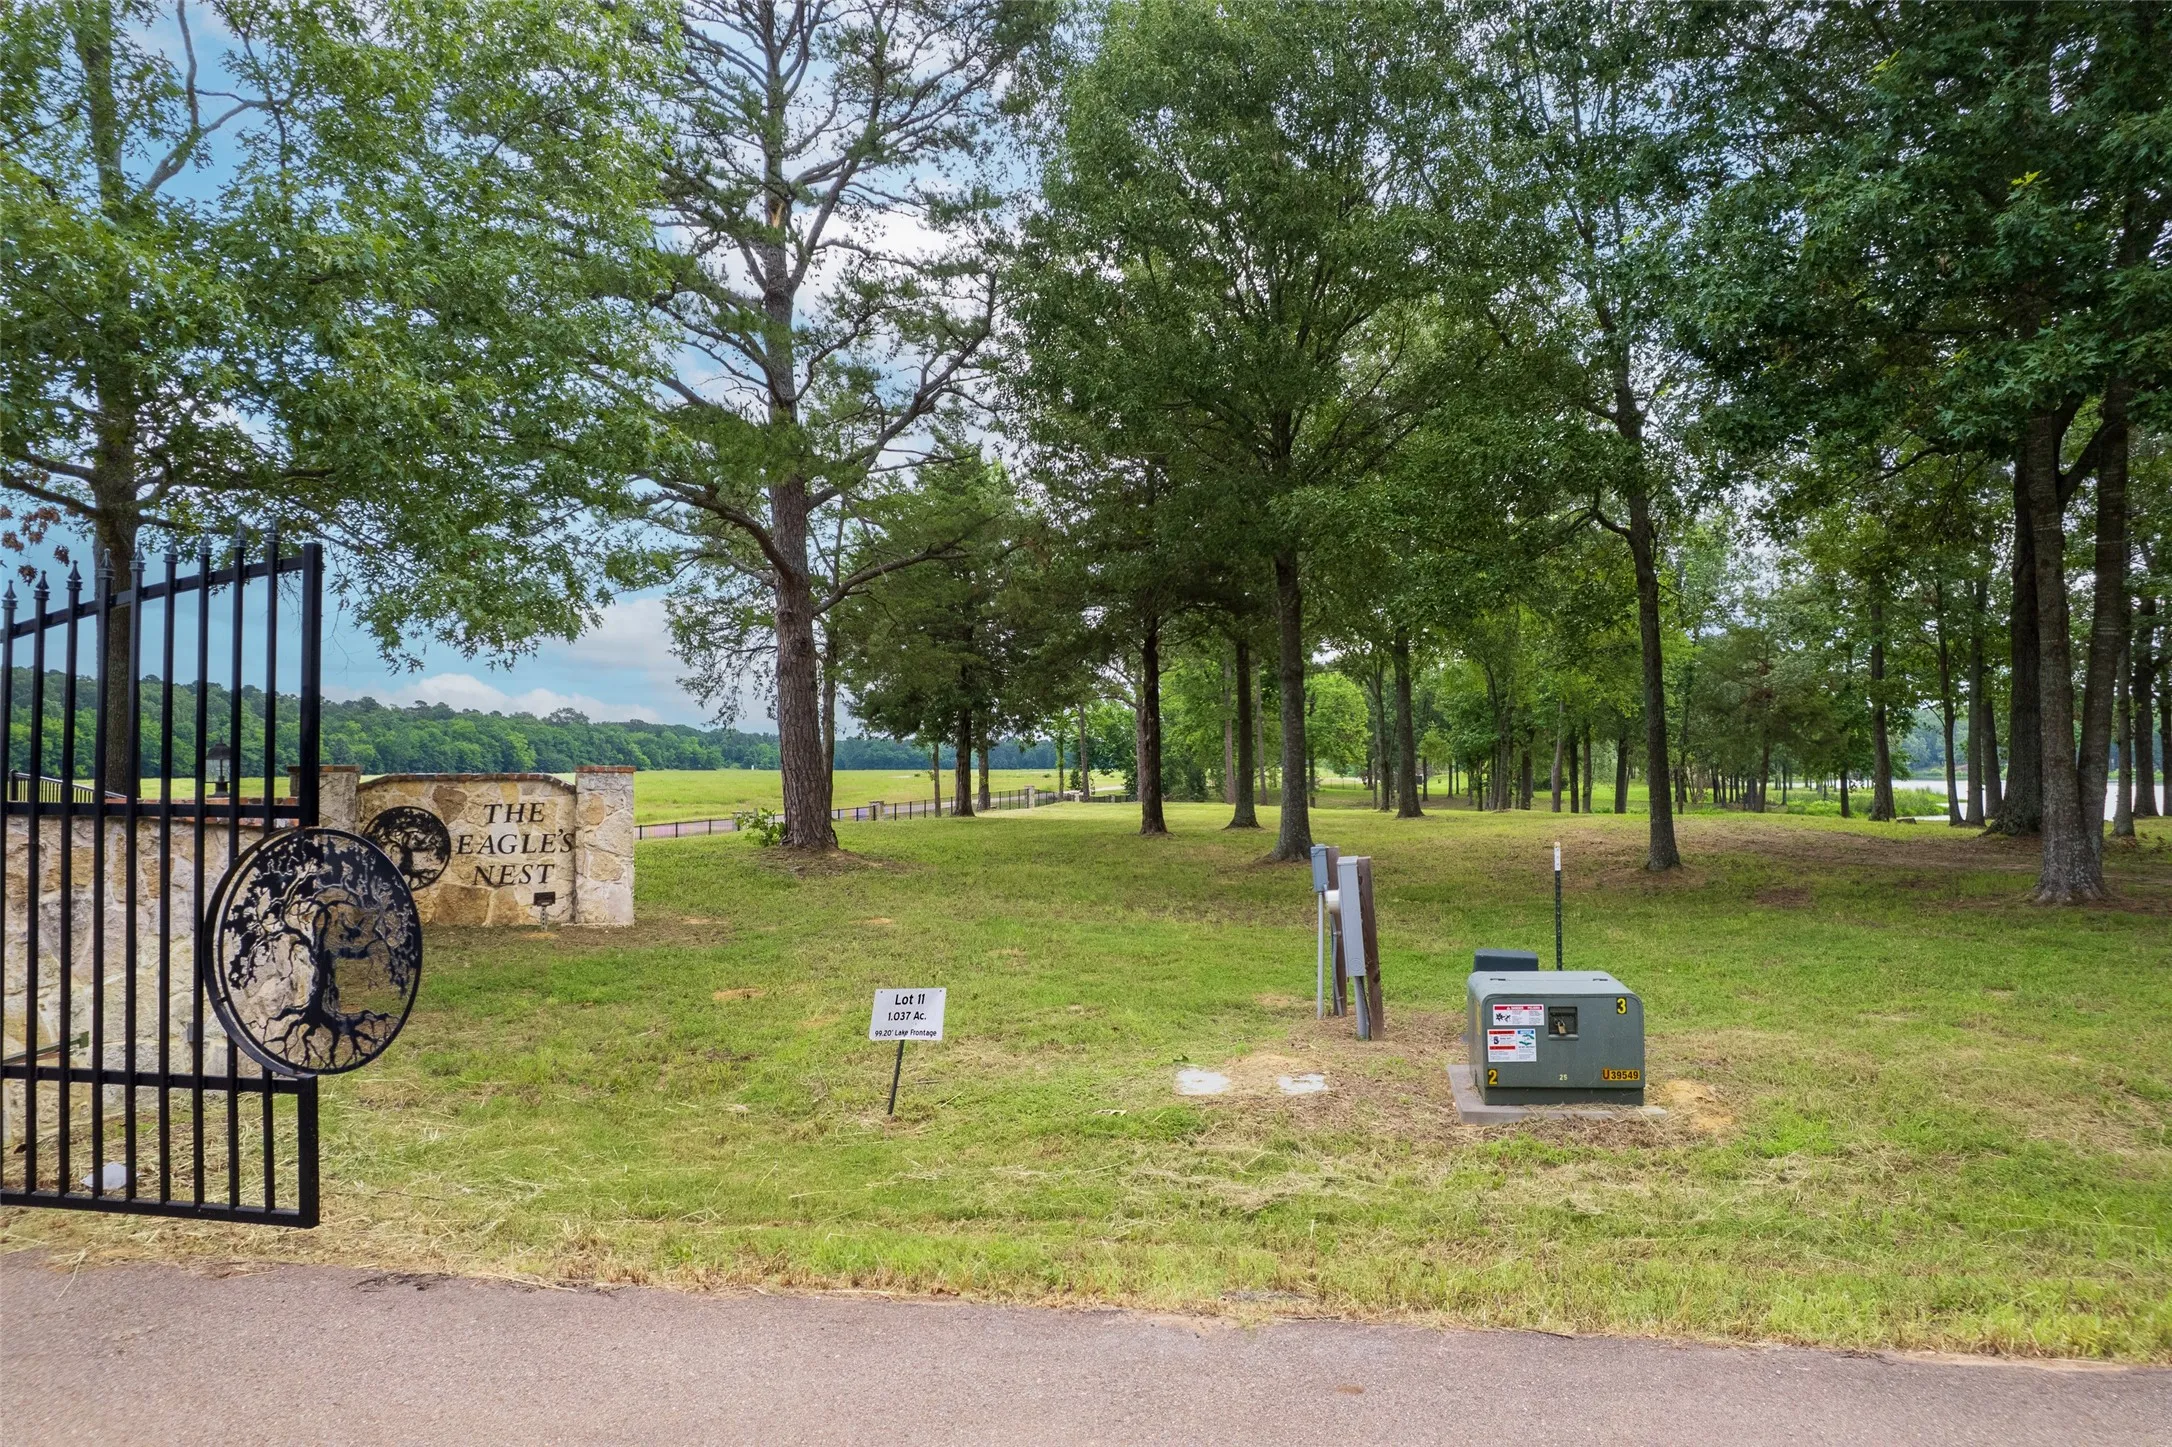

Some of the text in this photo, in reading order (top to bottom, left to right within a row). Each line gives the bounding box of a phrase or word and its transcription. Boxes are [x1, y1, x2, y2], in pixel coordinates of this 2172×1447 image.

[484, 802, 545, 824] THE
[456, 828, 575, 855] EAGLE'S
[474, 863, 556, 886] NEST
[895, 994, 925, 1005] Lot 11
[1617, 997, 1627, 1014] 3
[888, 1011, 927, 1021] 1.037 Ac.
[895, 1029, 908, 1037] Lake
[910, 1029, 937, 1038] Frontage
[1488, 1069, 1498, 1085] 2
[1602, 1069, 1639, 1080] U39549
